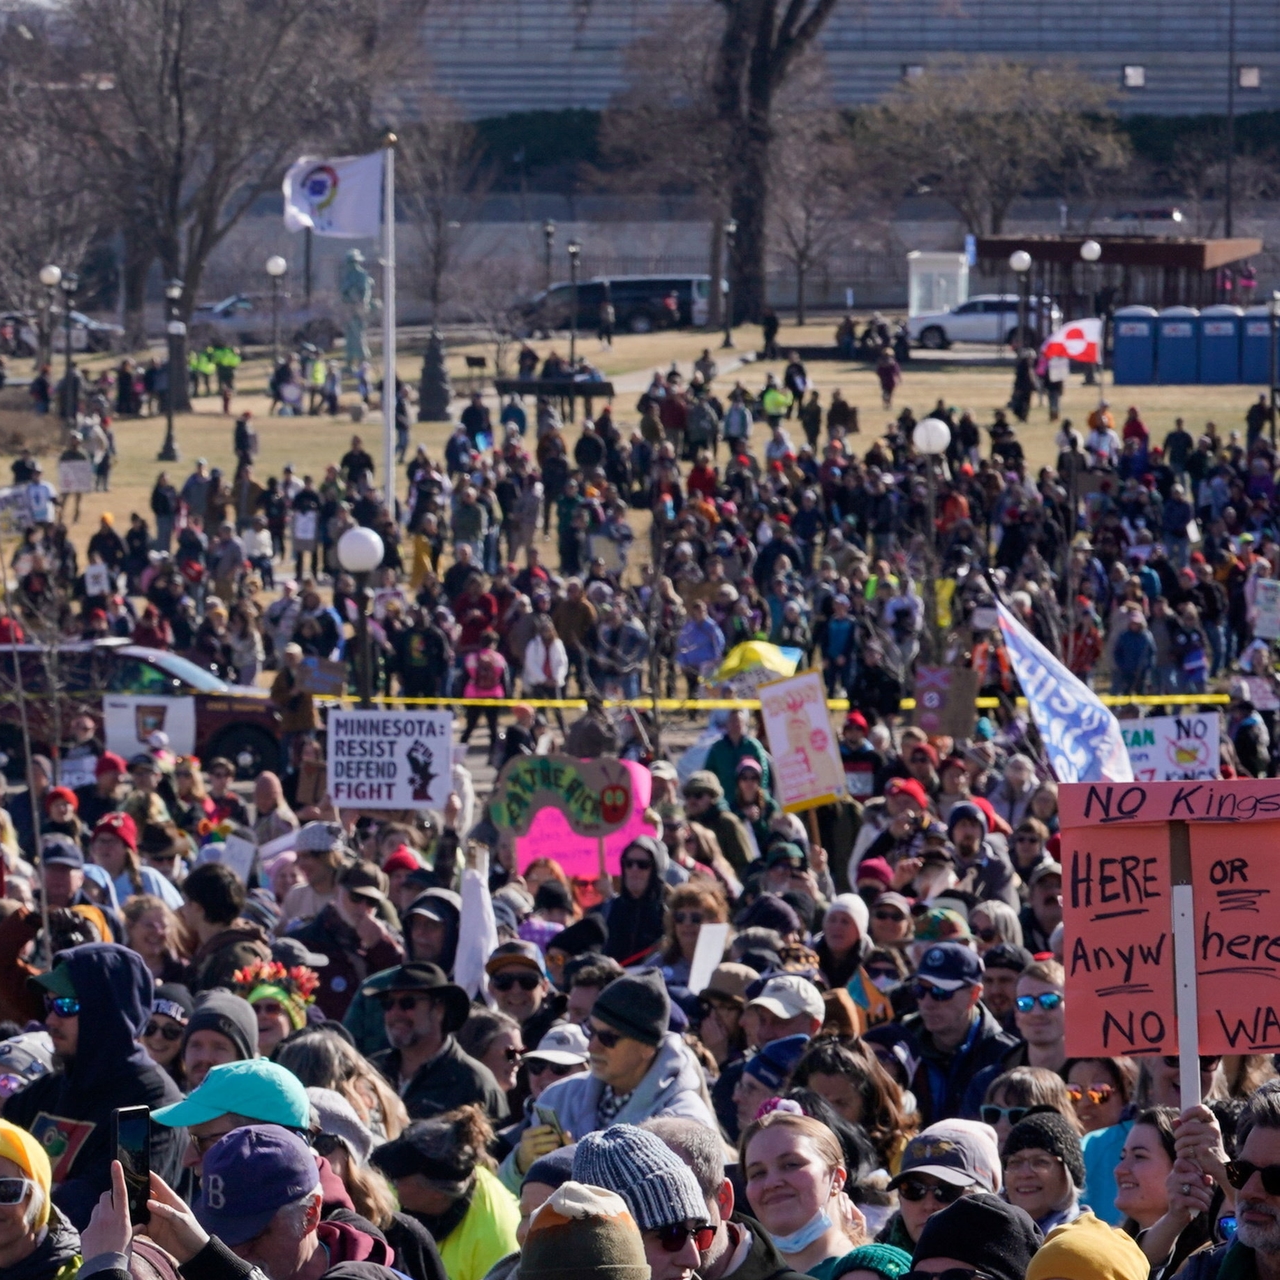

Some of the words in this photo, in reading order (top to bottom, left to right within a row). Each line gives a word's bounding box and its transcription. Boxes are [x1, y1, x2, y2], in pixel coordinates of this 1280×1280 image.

[335, 718, 446, 738] MINNESOTA:
[1175, 717, 1208, 740] NO
[335, 740, 397, 758] RESIST
[335, 761, 399, 780] DEFEND
[335, 782, 396, 801] FIGHT
[1084, 785, 1147, 819] NO
[1070, 850, 1163, 909] HERE
[1209, 858, 1249, 886] OR
[1102, 1009, 1166, 1049] NO
[207, 1174, 226, 1209] B
